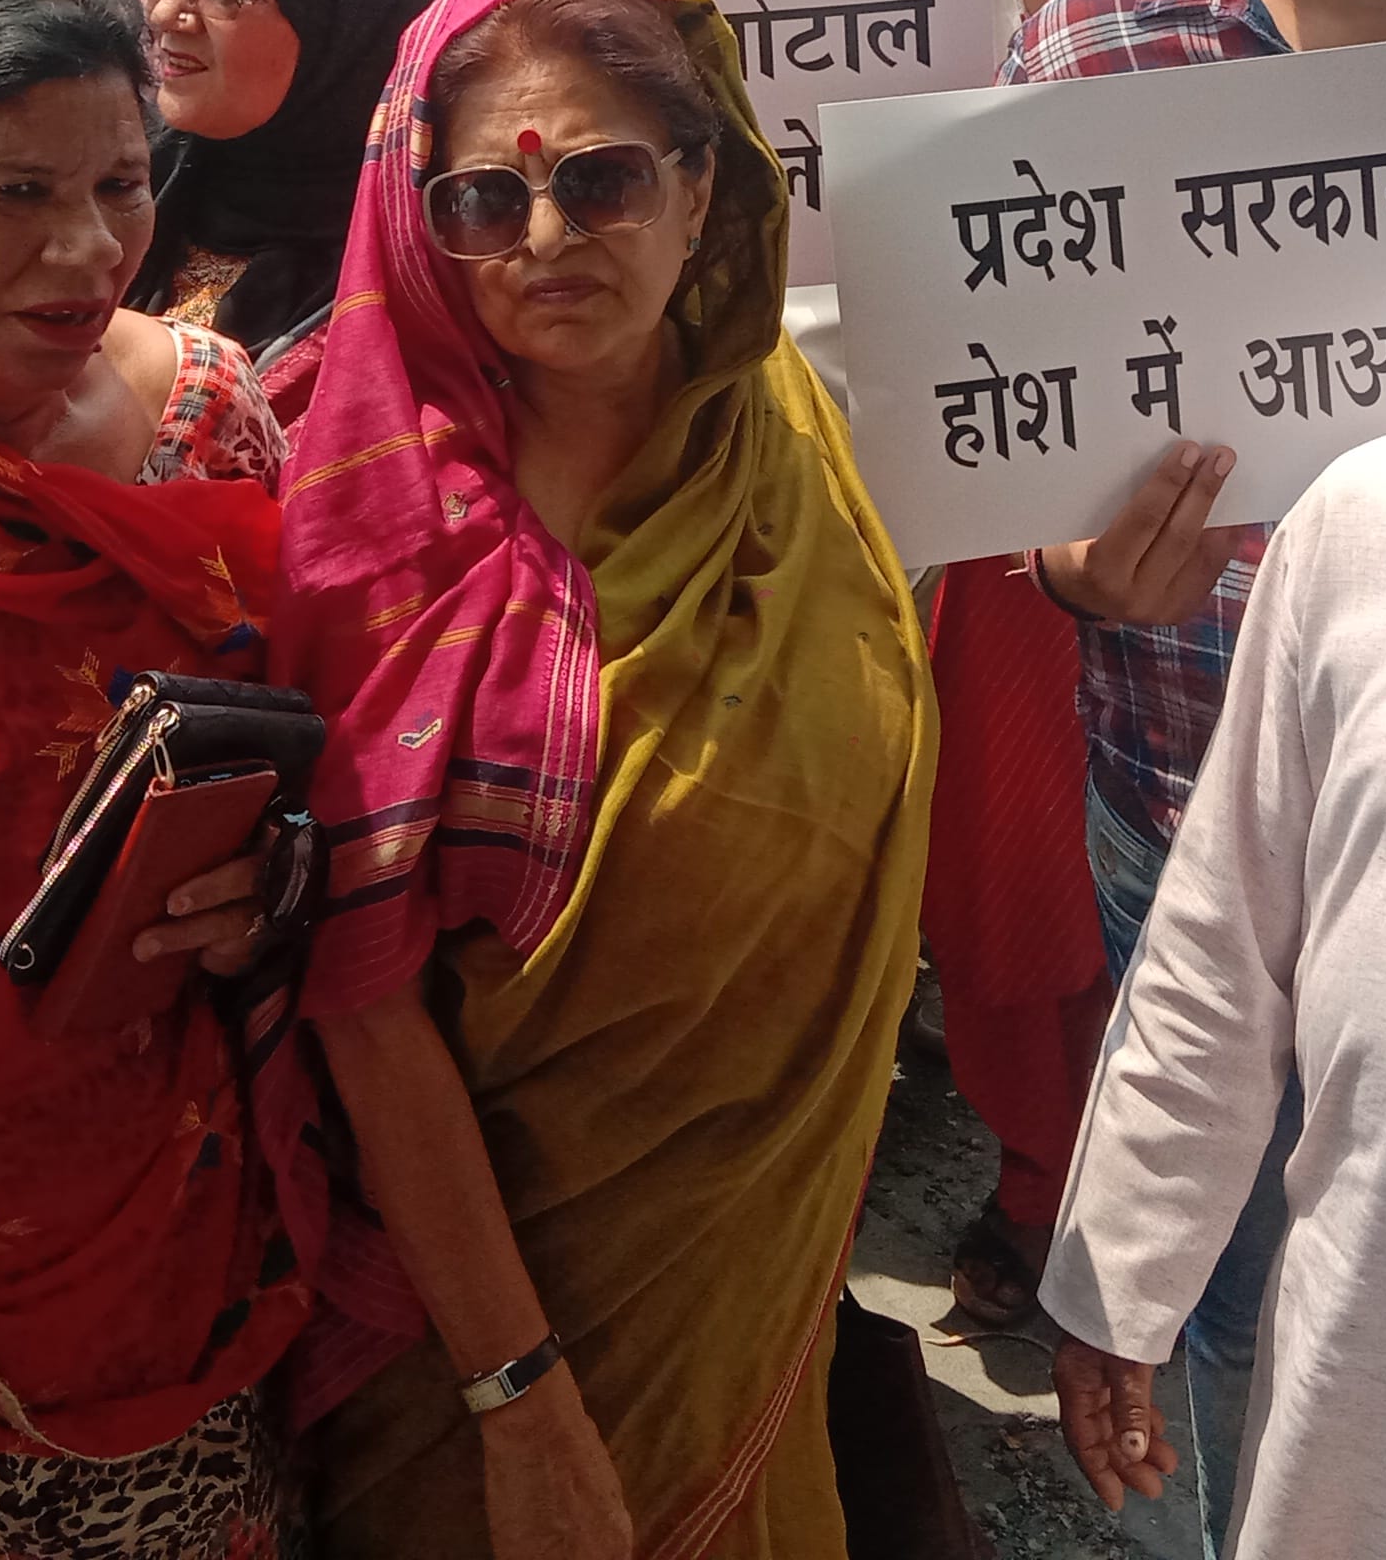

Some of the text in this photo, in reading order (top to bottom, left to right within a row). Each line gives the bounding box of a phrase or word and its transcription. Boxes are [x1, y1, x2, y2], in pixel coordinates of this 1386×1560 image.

[951, 160, 1125, 292] प्रदेश
[935, 343, 1077, 469] होश
[1126, 315, 1183, 436] में
